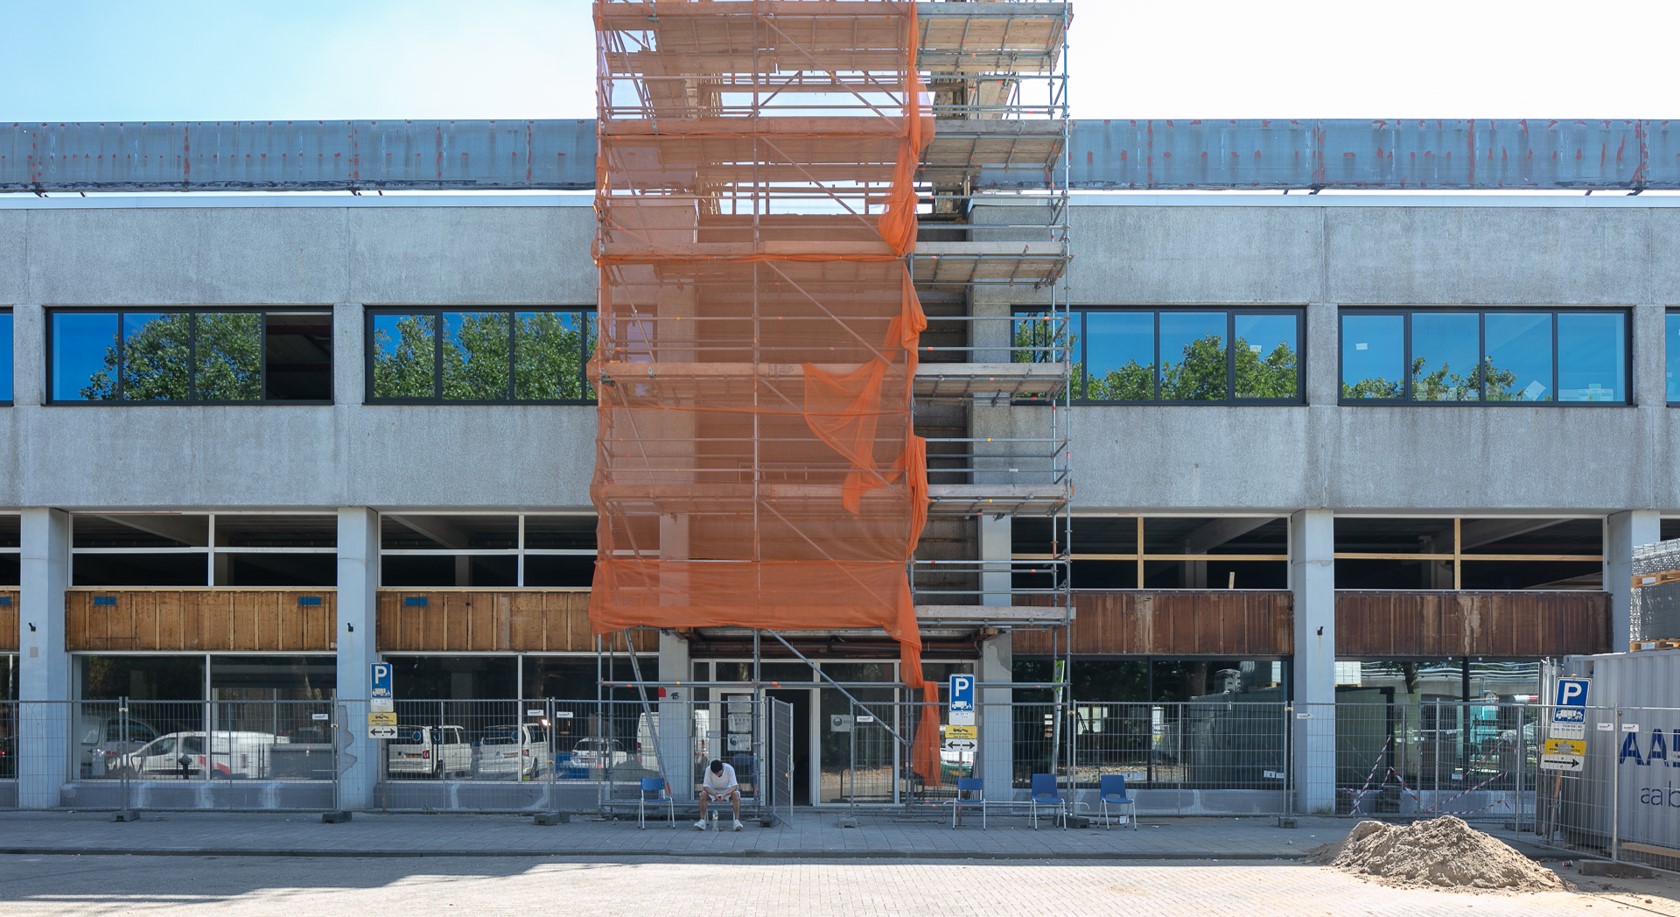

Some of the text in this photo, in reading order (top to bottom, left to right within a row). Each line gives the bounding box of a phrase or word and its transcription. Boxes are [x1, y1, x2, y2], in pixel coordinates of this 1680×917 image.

[375, 665, 387, 684] P
[955, 677, 969, 697] P
[1562, 682, 1582, 704] P
